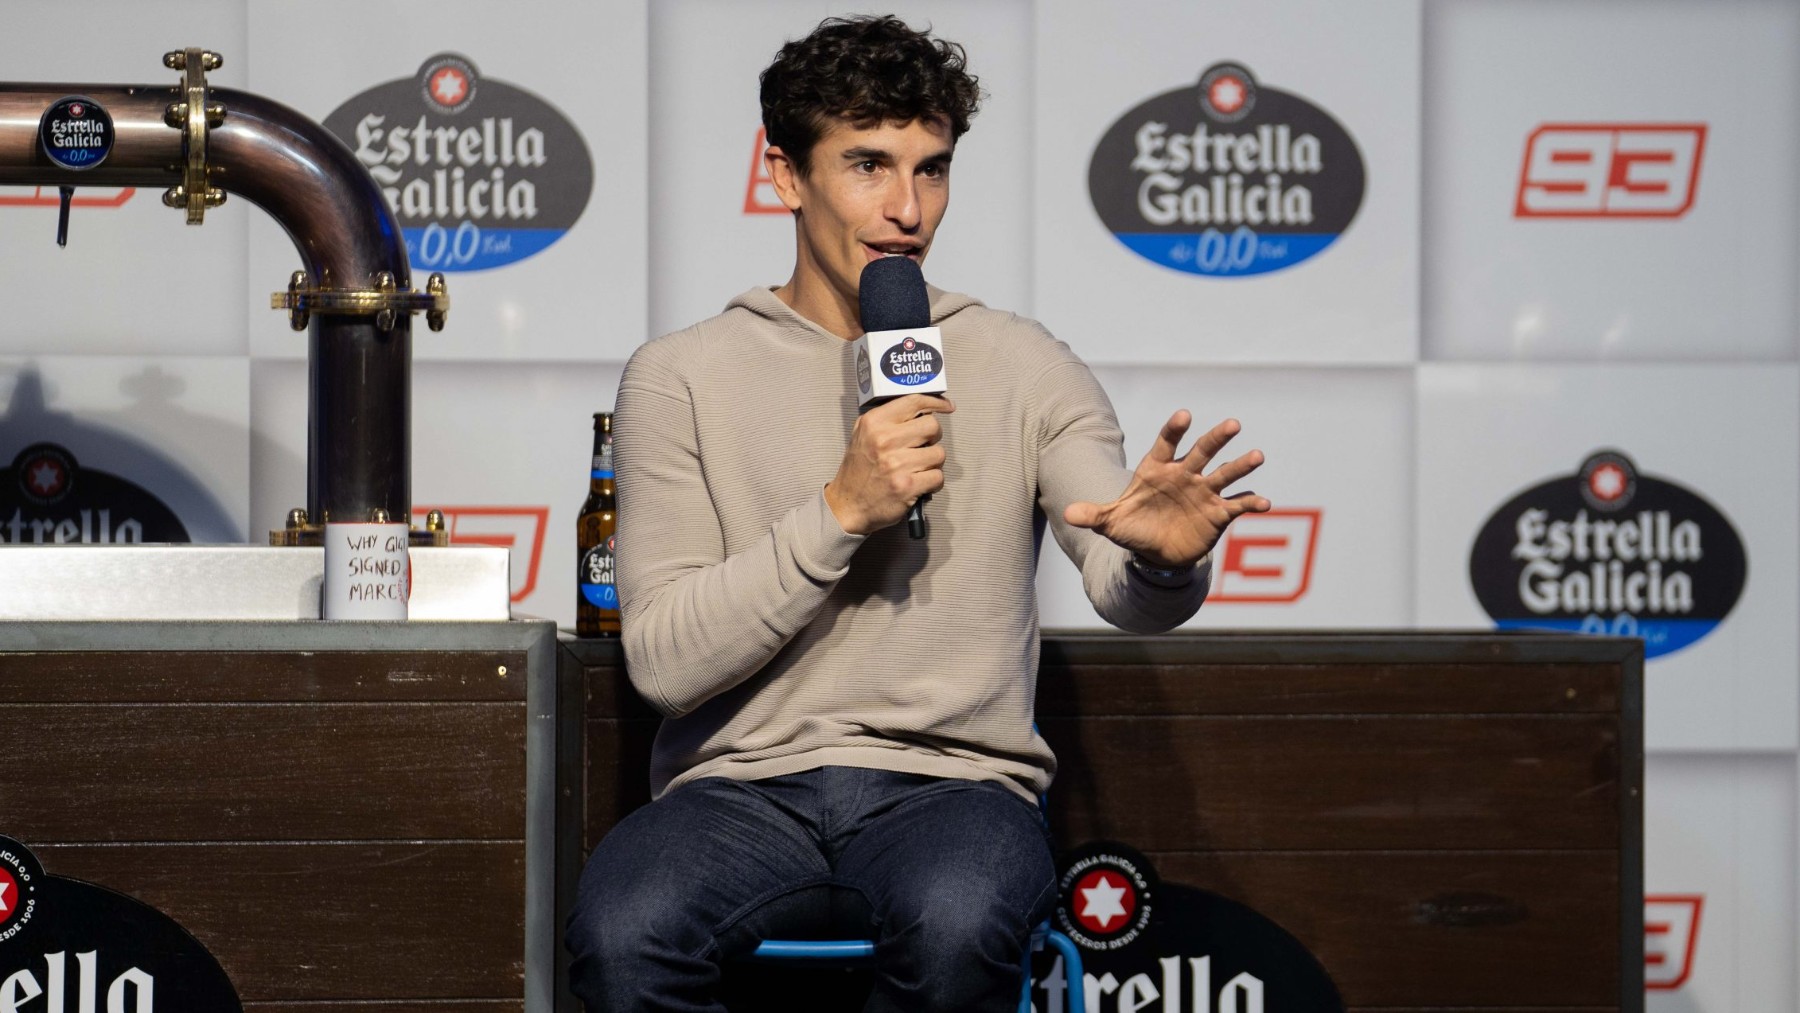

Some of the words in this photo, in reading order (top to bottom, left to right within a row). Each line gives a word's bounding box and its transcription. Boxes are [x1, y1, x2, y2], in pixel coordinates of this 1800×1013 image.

[51, 119, 104, 133] Estrella
[53, 133, 102, 147] Galicia
[355, 113, 547, 167] Estrella
[70, 149, 88, 162] 0,0
[1130, 121, 1322, 174] Estrella
[1512, 122, 1708, 219] 93
[1137, 172, 1315, 226] Galicia
[420, 220, 480, 266] 0,0
[1195, 225, 1258, 273] 0,0
[889, 350, 933, 364] Estrella
[892, 363, 932, 375] Galicia
[906, 373, 921, 385] 0,0
[0, 507, 143, 544] trella
[1511, 507, 1703, 562] Estrella
[347, 534, 378, 551] WHY
[348, 556, 401, 578] SIGNED
[1517, 559, 1694, 613] Galicia
[1061, 856, 1099, 888] ESTRELLA
[1099, 854, 1136, 874] GALICIA
[20, 898, 36, 924] 1906
[1108, 928, 1140, 950] DESDE
